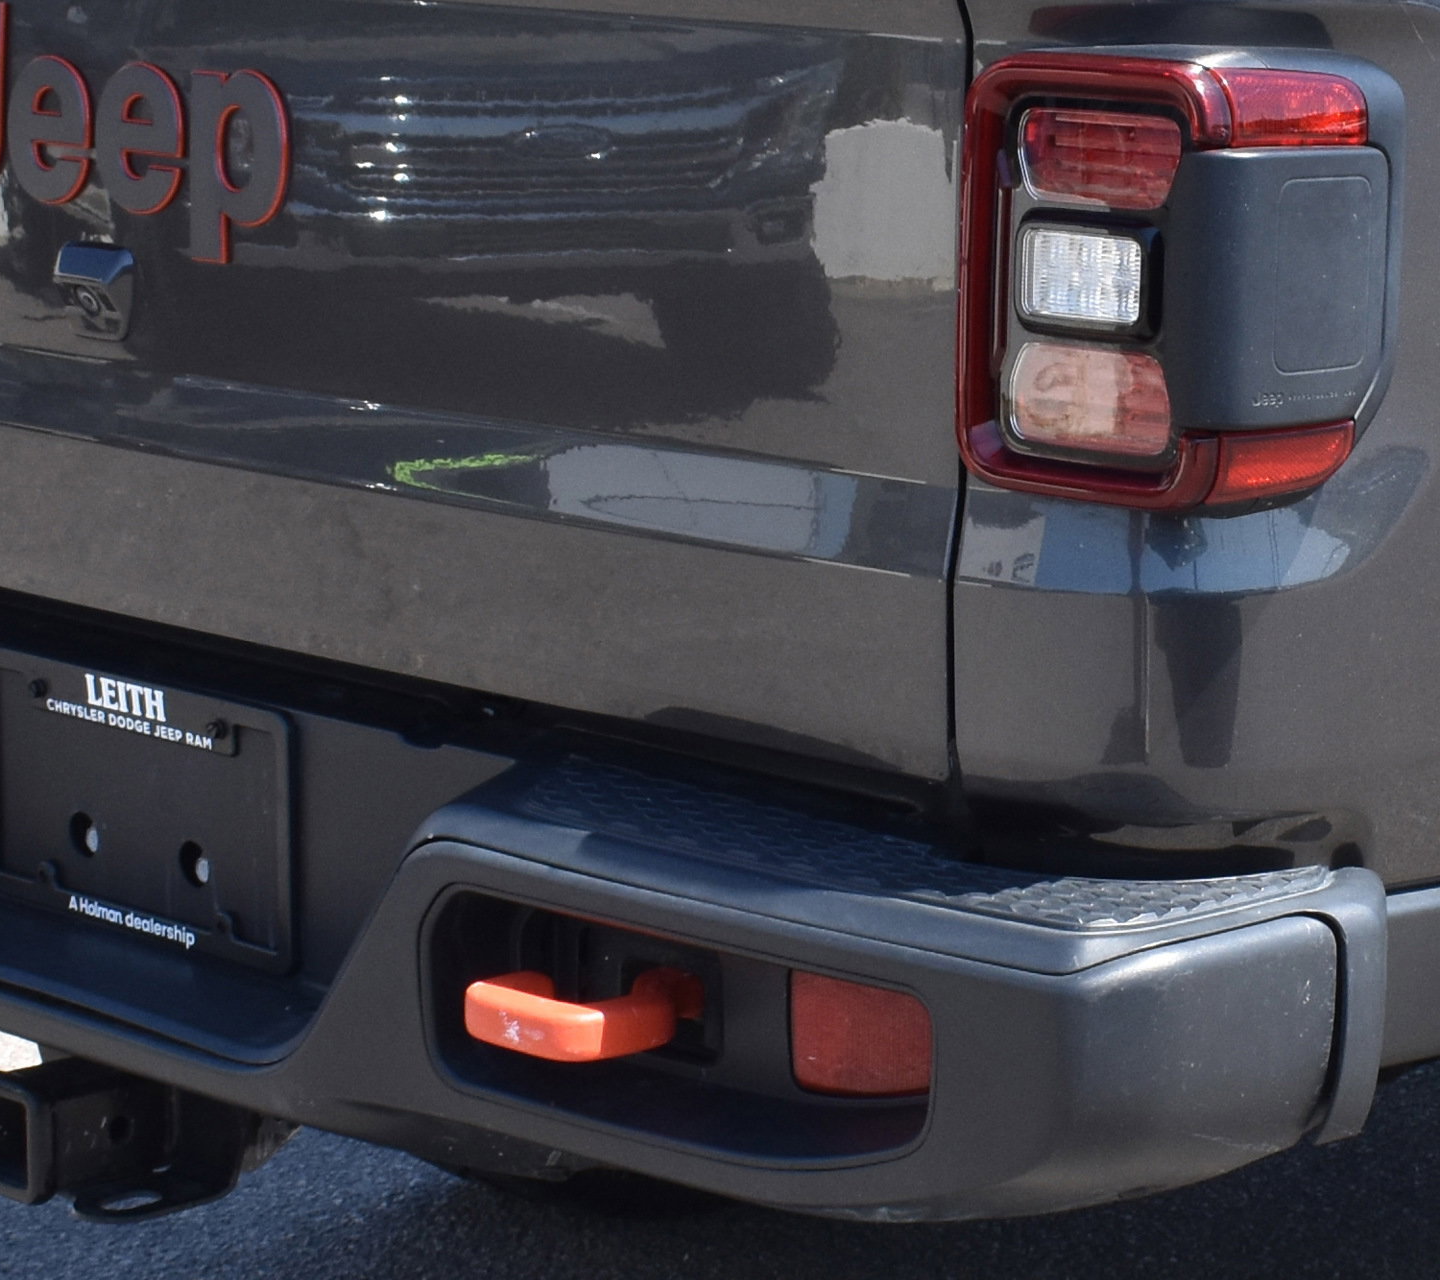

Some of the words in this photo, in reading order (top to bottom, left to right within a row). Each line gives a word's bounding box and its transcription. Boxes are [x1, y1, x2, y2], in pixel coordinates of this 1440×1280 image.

[84, 673, 167, 722] LEITH
[46, 698, 106, 724] CHRYSLER
[108, 712, 151, 735] DODGE
[153, 724, 183, 743] JEEP
[185, 732, 213, 751] RAM
[68, 895, 78, 911] A
[79, 897, 123, 925] Holman
[124, 912, 196, 949] dealership
